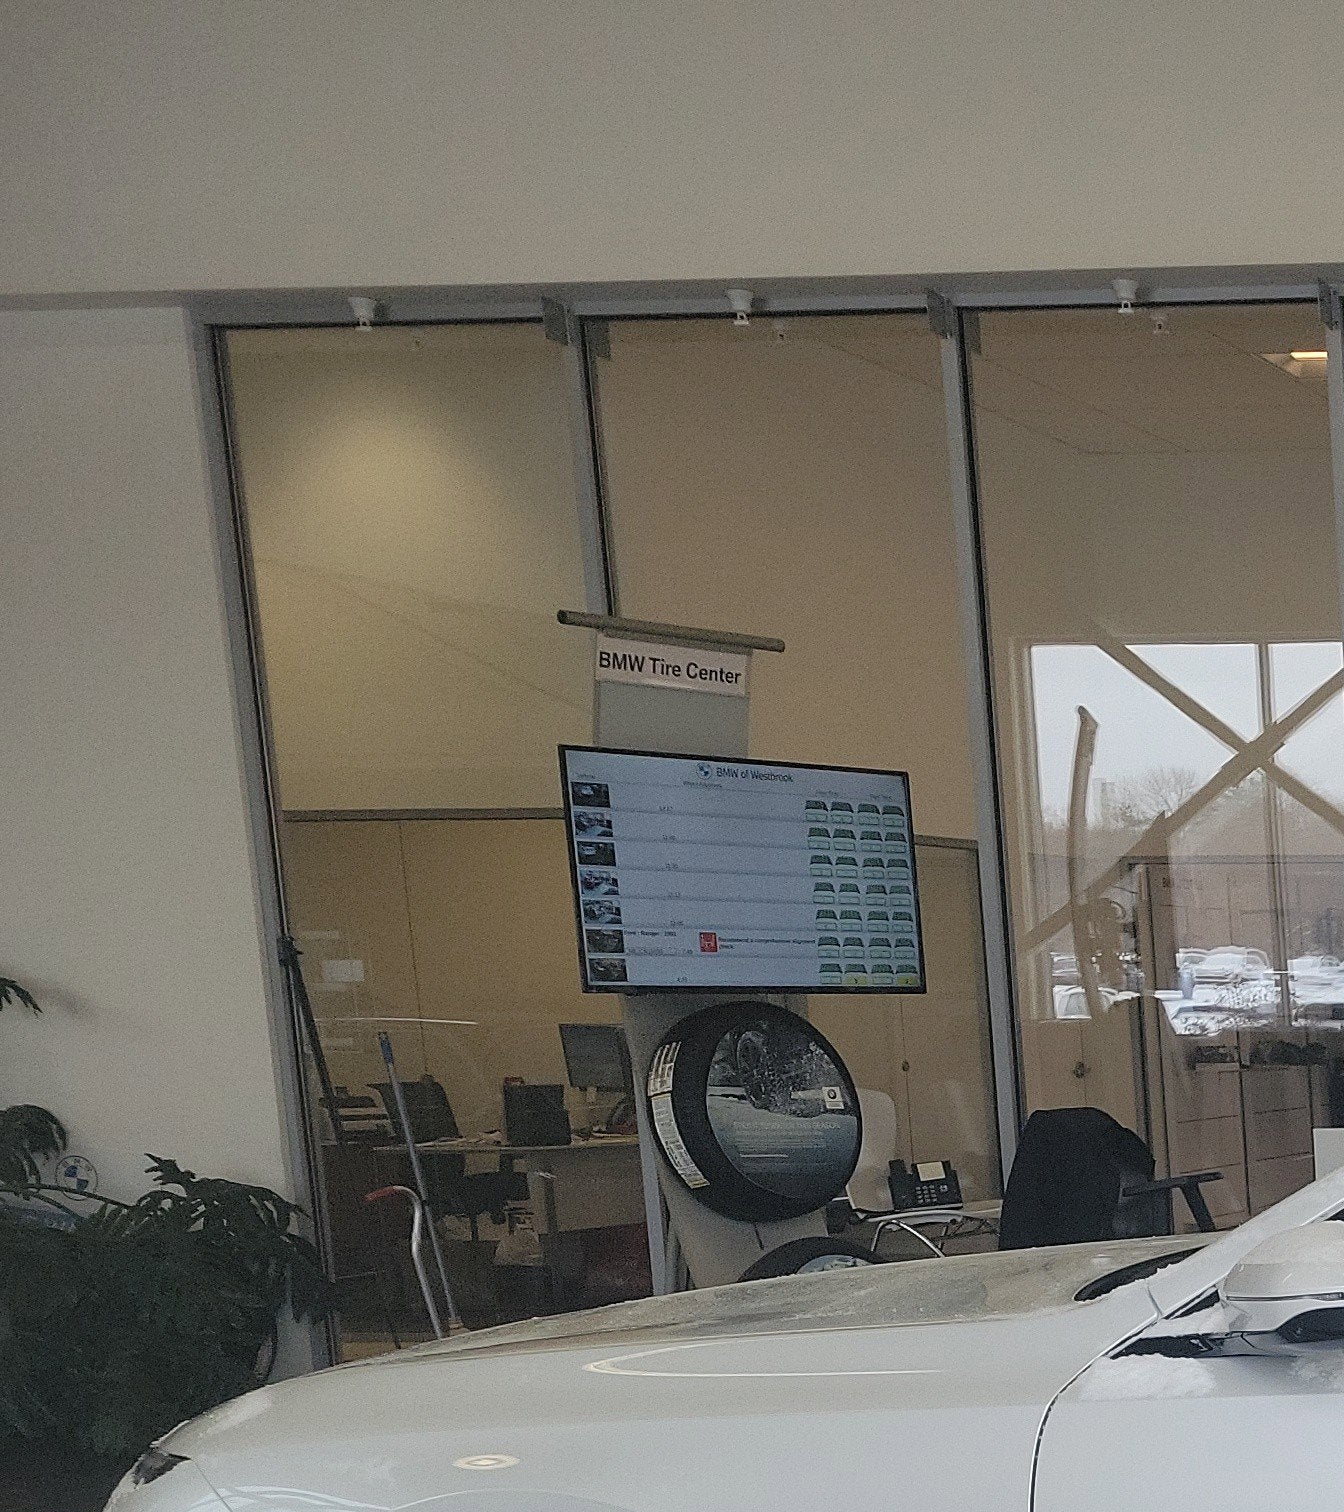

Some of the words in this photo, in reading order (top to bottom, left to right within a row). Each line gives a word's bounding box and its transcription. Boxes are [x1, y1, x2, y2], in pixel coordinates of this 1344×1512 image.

[599, 651, 645, 673] BMW
[648, 657, 681, 677] Tire
[686, 661, 742, 684] Center
[716, 767, 739, 778] BMW
[740, 769, 749, 778] of
[750, 769, 794, 782] Westbrook
